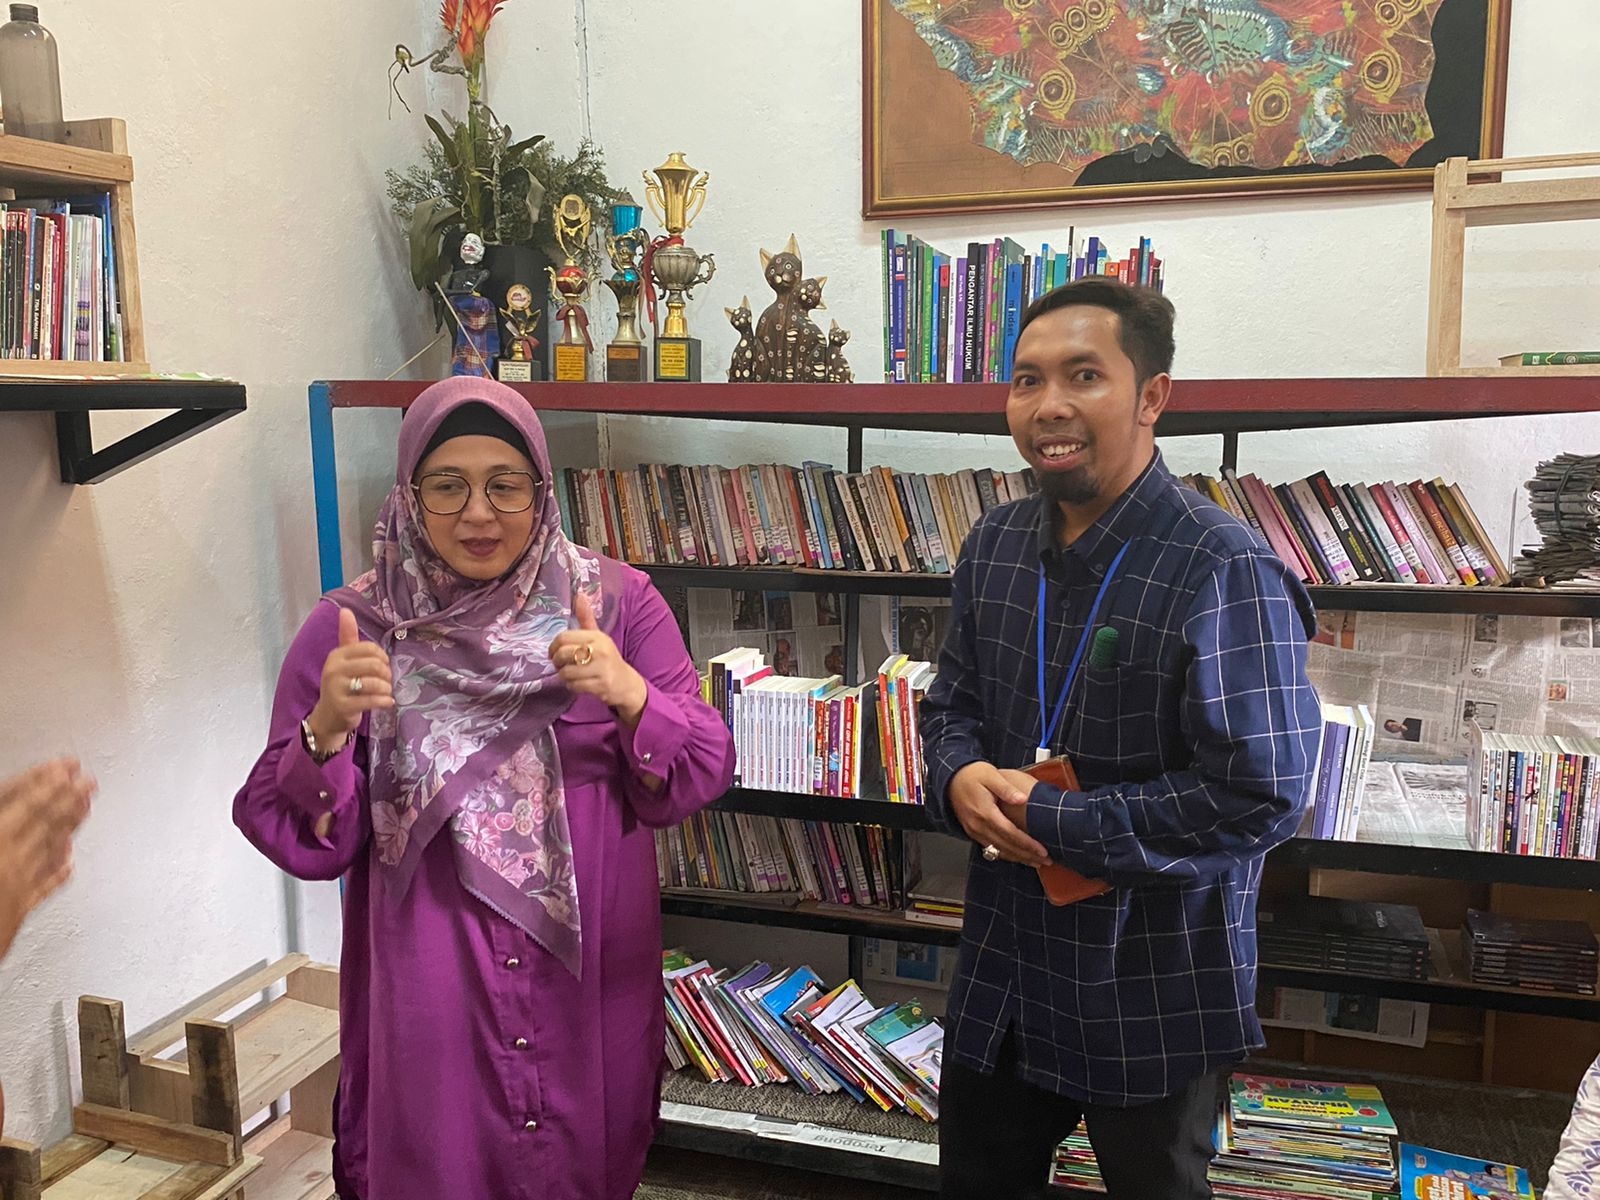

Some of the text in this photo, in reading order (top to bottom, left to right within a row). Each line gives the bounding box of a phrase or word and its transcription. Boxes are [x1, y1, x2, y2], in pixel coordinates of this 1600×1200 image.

[967, 265, 975, 315] PENGANTAR
[1006, 300, 1015, 336] mindset
[845, 500, 863, 541] Atomic Habits
[1267, 1097, 1348, 1107] HIJAIYAH
[814, 1134, 887, 1152] Teropong
